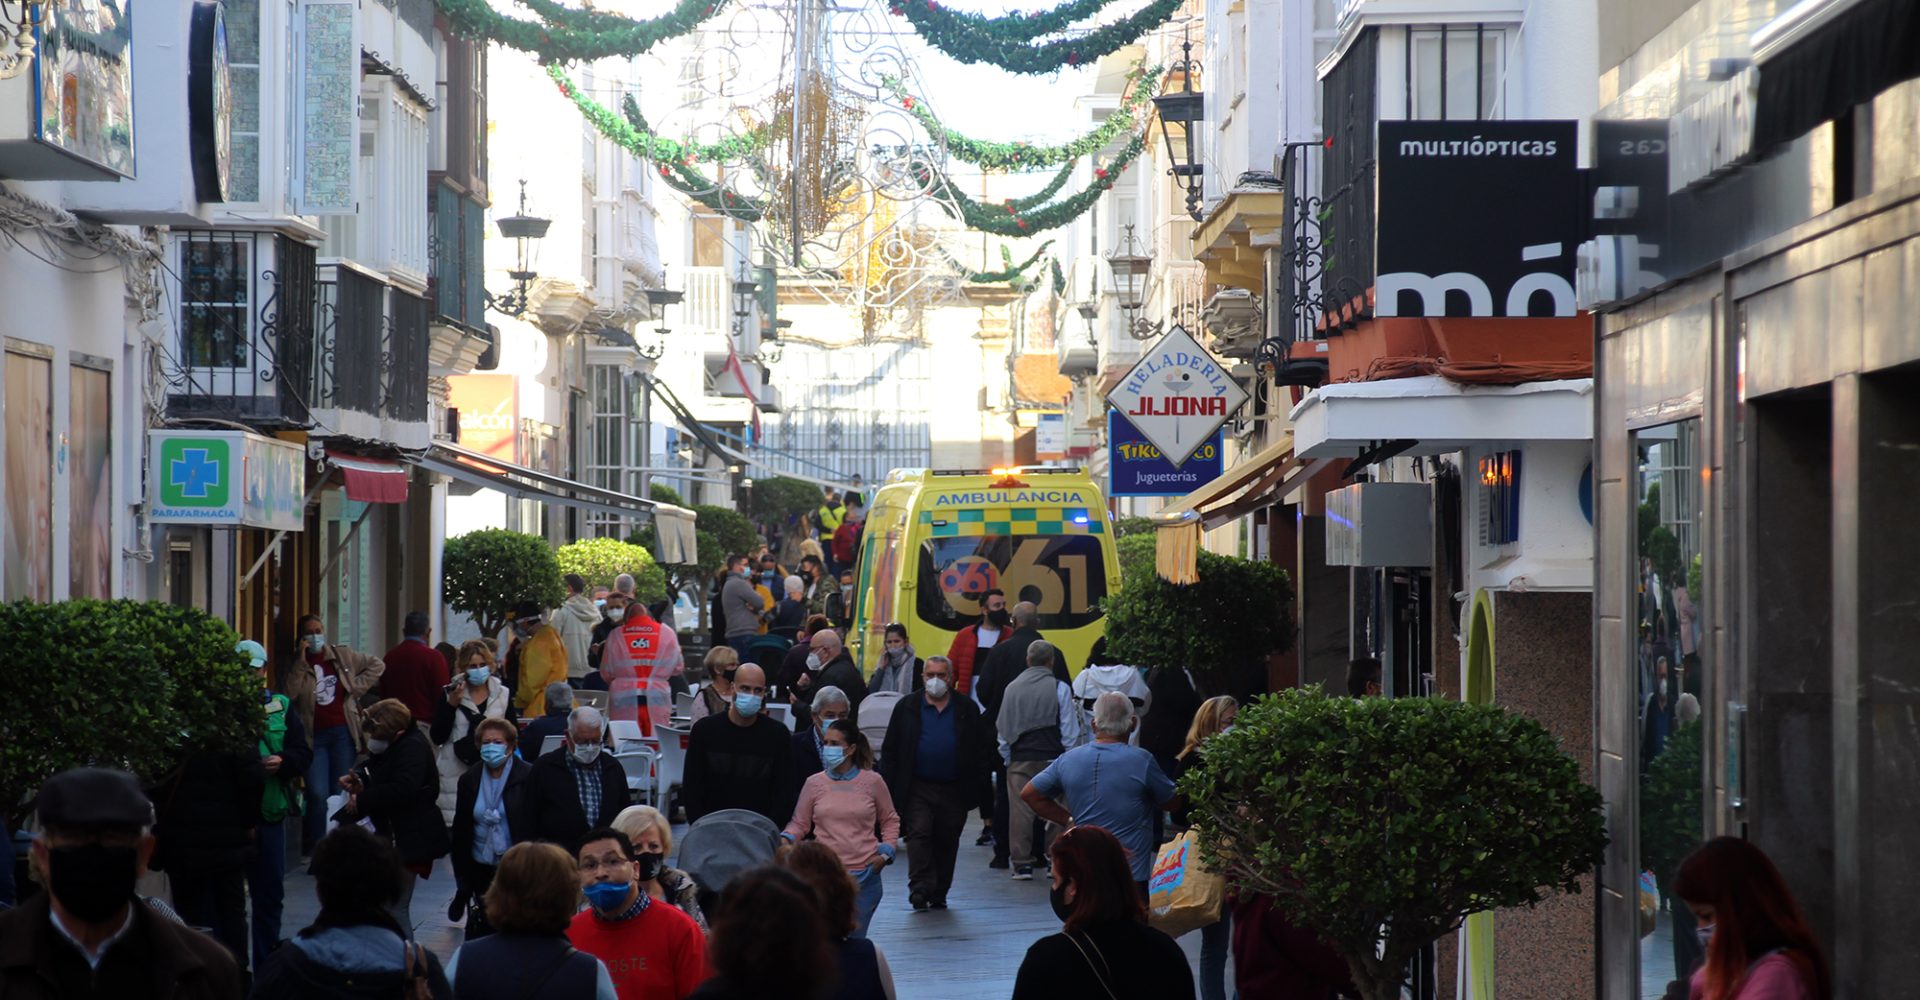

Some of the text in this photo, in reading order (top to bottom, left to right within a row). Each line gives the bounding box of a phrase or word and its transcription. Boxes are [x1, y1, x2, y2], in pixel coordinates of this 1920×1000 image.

[1127, 352, 1227, 396] HELADERIA
[459, 397, 514, 431] alcón
[1129, 397, 1226, 416] JIJONA
[1136, 471, 1197, 485] Jugueterías
[936, 491, 1083, 506] AMBULANCIA
[152, 509, 236, 518] PARAFARMACIA
[608, 956, 648, 972] OSTE
